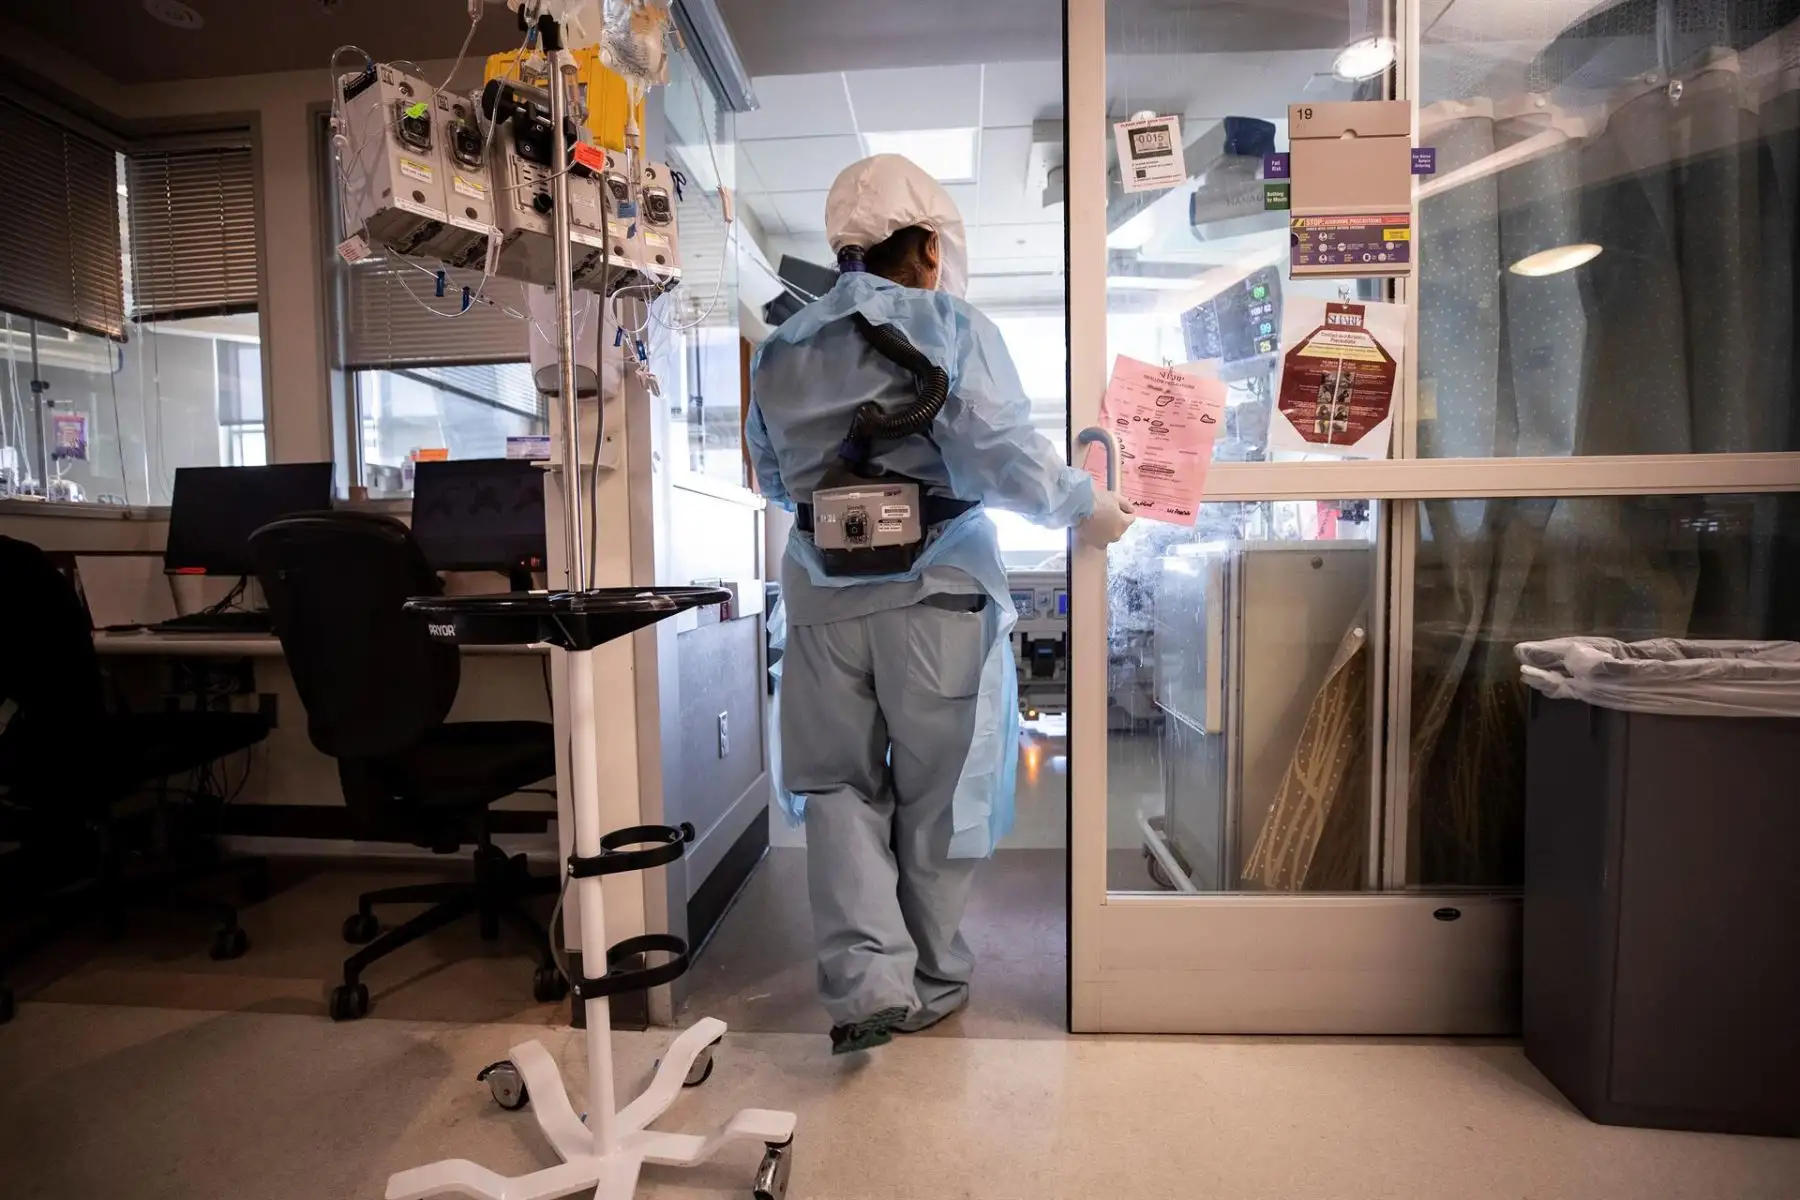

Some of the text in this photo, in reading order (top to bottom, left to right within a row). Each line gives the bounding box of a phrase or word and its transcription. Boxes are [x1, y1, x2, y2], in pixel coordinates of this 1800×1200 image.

[1297, 108, 1312, 120] 19
[1328, 313, 1361, 326] SHARP
[428, 624, 456, 636] PRYOR
